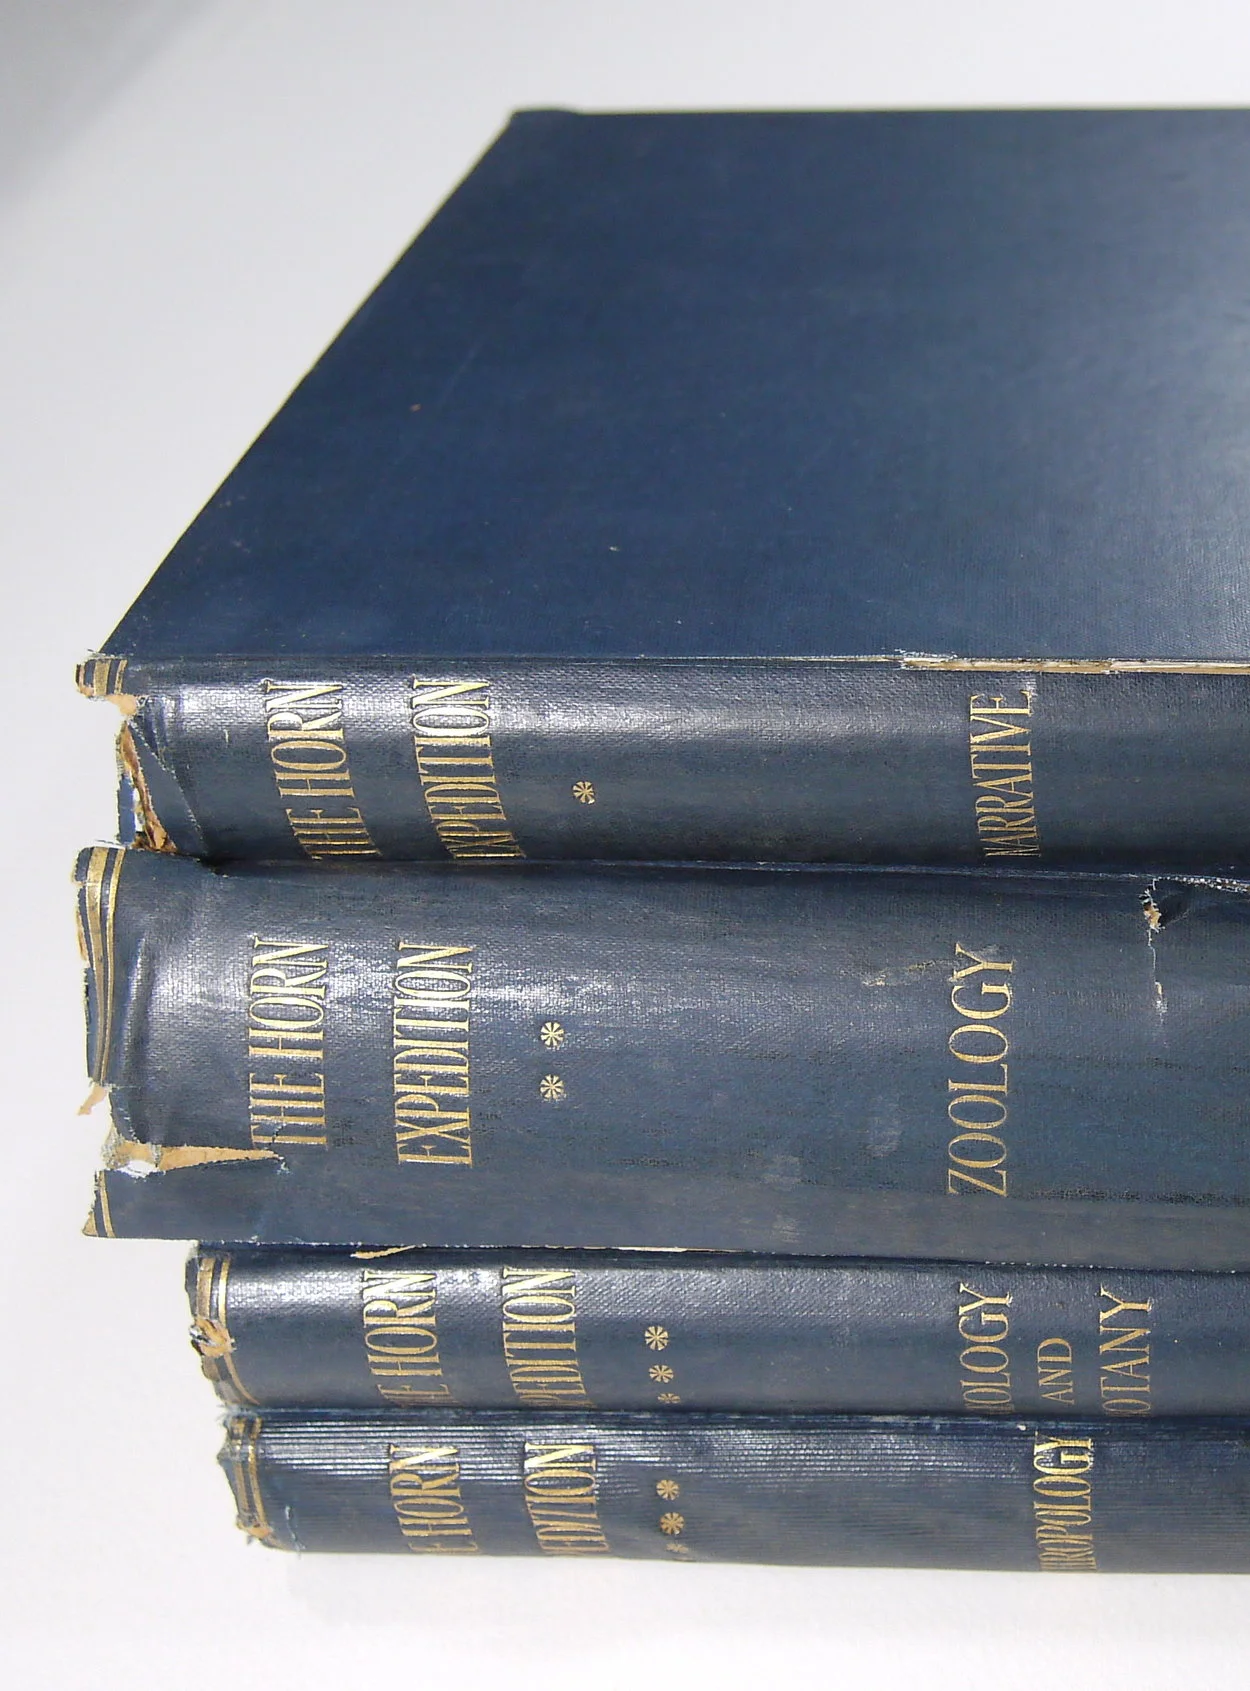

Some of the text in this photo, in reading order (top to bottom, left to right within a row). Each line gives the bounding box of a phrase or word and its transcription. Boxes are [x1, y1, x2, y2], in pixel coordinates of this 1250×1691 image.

[265, 679, 383, 861] THE HORN
[412, 676, 527, 858] EXPEDITION
[968, 690, 1042, 858] NARRATIVE
[248, 936, 329, 1151] THE HORN
[393, 940, 474, 1168] EXPEDITION
[947, 942, 1017, 1197] ZOOLOGY
[363, 1270, 444, 1376] HORN
[1037, 1337, 1075, 1405] AND
[389, 1443, 474, 1537] HORN
